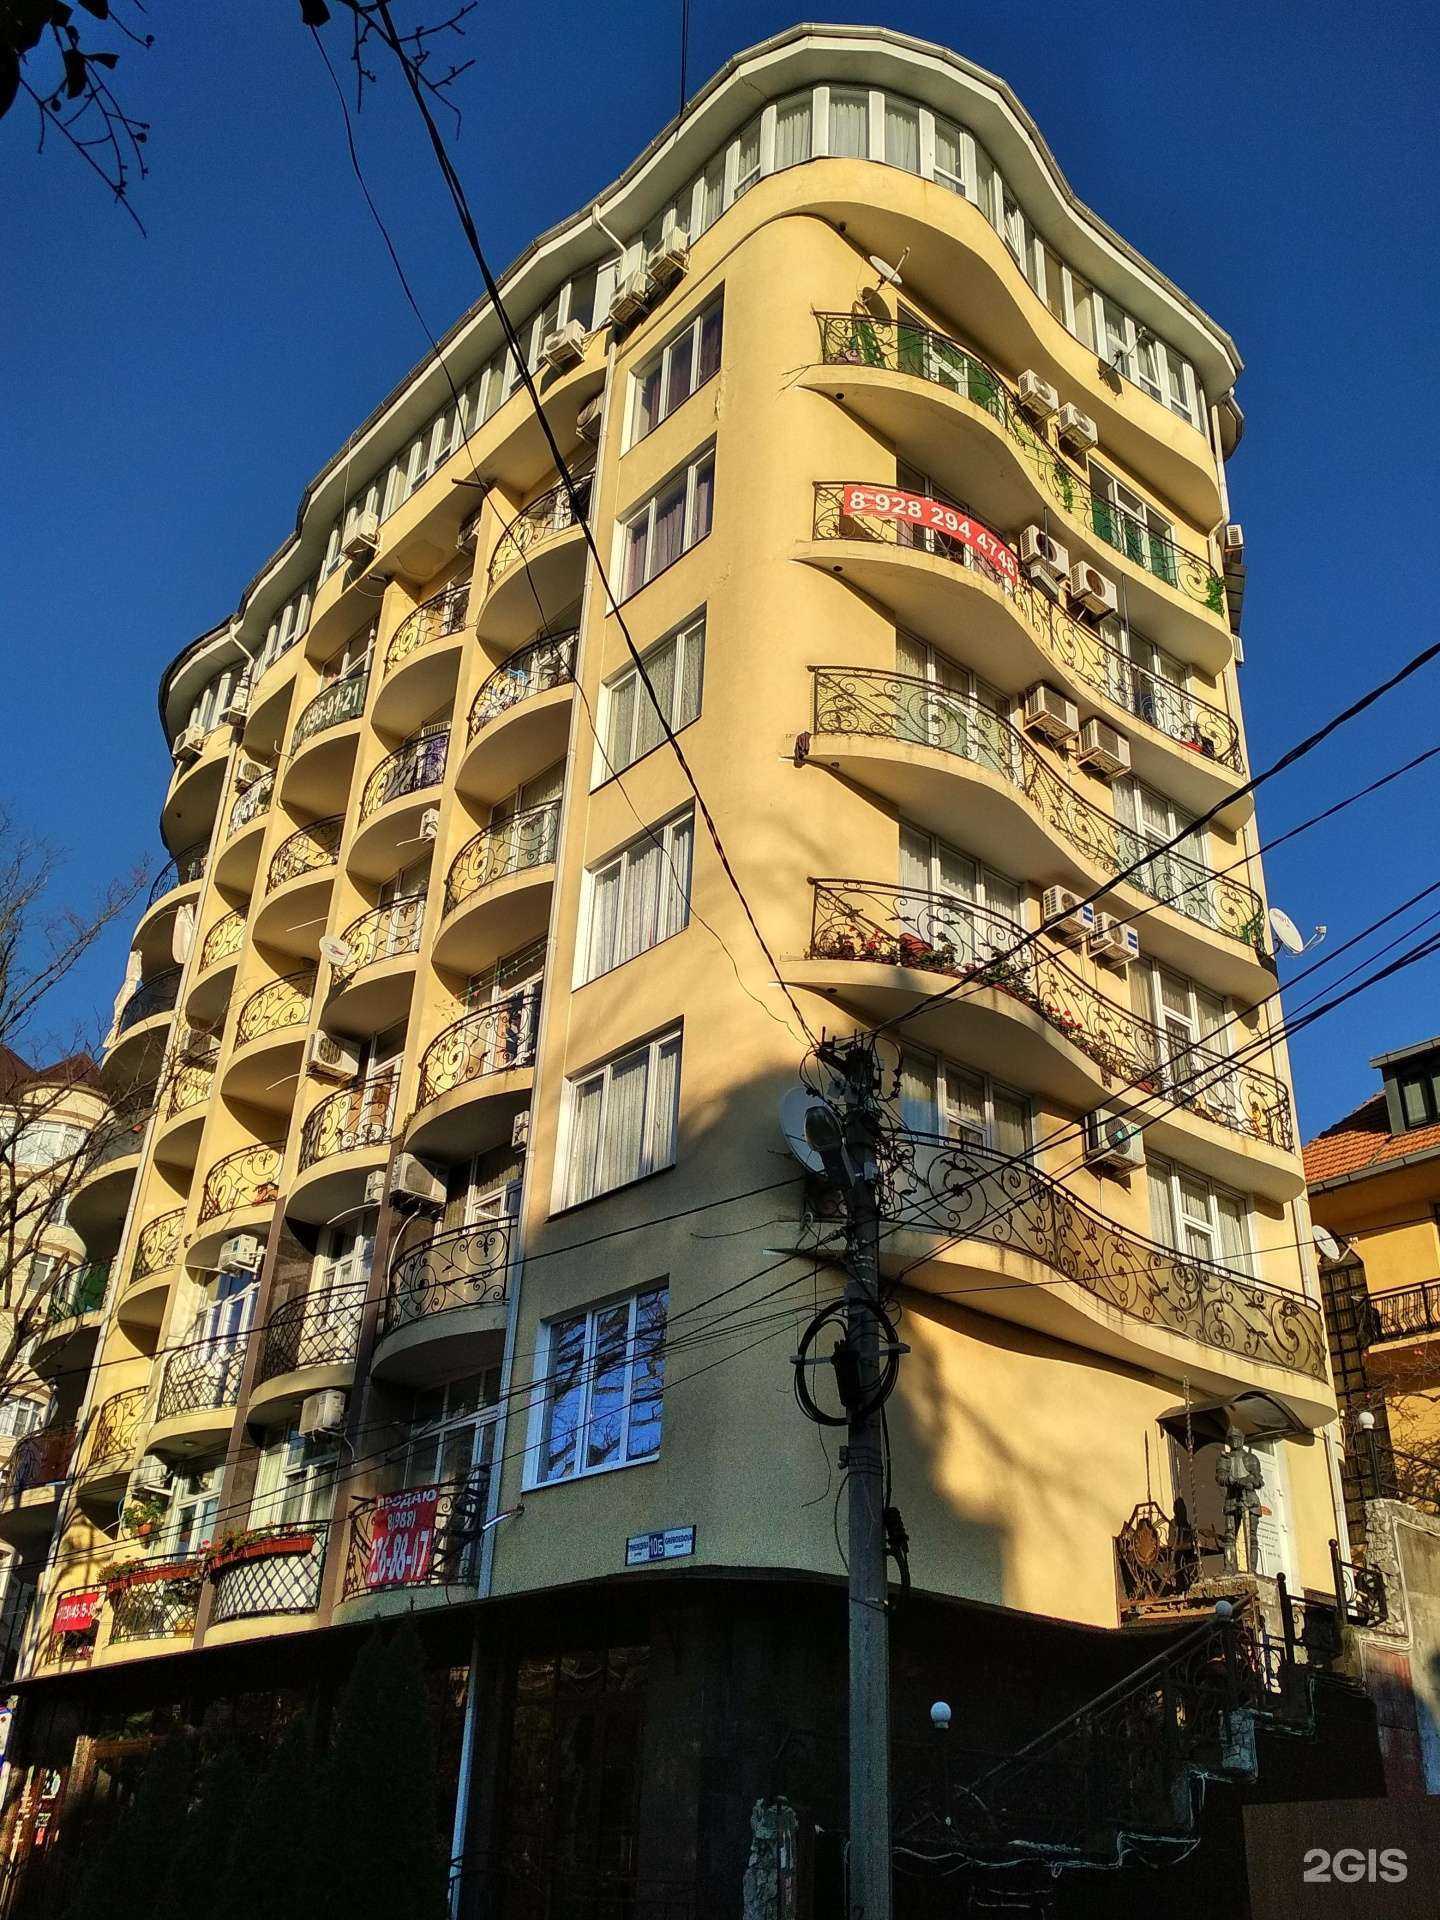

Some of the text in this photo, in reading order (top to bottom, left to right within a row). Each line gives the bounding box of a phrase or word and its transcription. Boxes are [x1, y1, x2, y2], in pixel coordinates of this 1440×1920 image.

[849, 491, 922, 517] 8-928
[930, 507, 972, 538] 294
[377, 1489, 437, 1510] ПРОДАЮ
